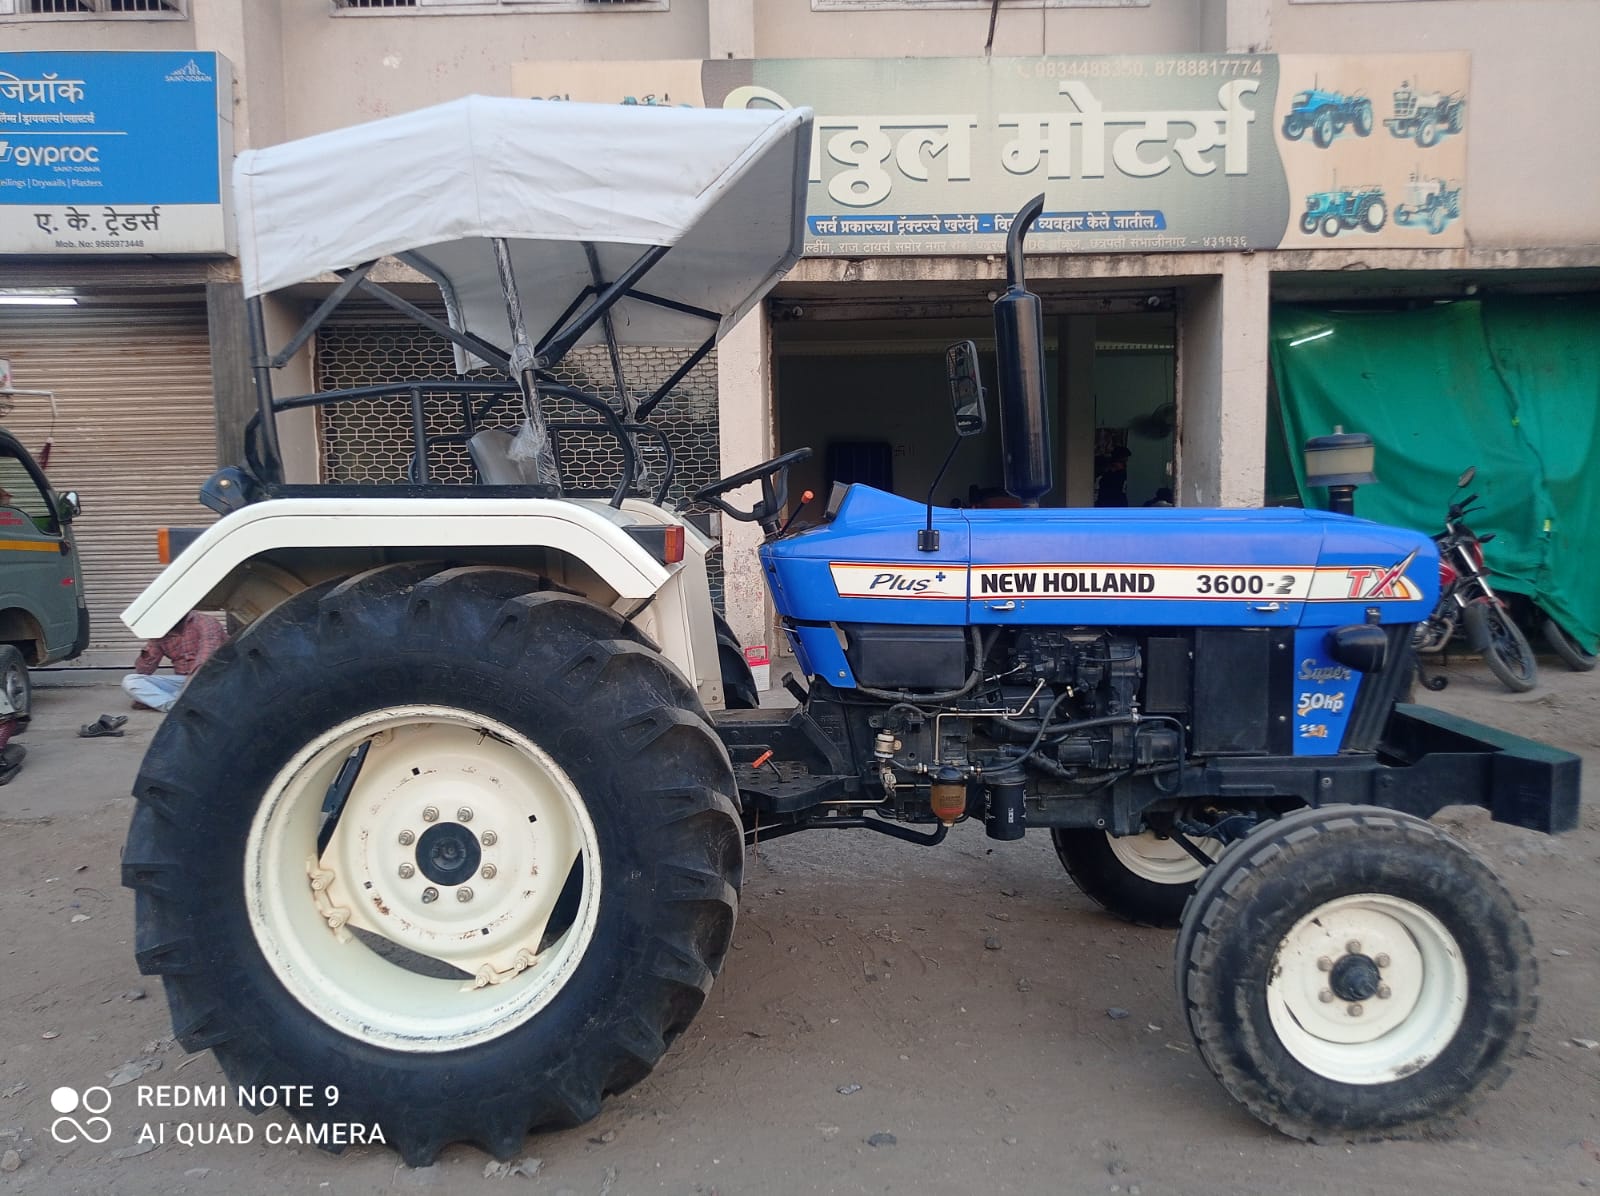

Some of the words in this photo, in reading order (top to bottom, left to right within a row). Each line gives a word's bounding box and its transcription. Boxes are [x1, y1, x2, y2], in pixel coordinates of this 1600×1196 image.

[1154, 59, 1263, 77] 8788817774
[999, 79, 1260, 180] मोटर्स
[14, 146, 100, 167] gyproc
[0, 178, 26, 188] eilings
[34, 213, 59, 234] ए.
[65, 206, 97, 232] के.
[102, 205, 160, 236] ट्रेडर्स
[816, 216, 838, 233] सर्व
[840, 220, 895, 233] प्रकारच्या
[897, 215, 941, 236] ट्रॅक्टरचे
[943, 214, 979, 234] खरेदी
[1038, 217, 1084, 233] व्यवहार
[1086, 212, 1111, 229] केले
[1113, 211, 1159, 229] जातील.
[55, 240, 77, 248] Mob.
[78, 240, 94, 248] No:
[839, 243, 859, 253] राज
[1130, 233, 1187, 248] संभाजीनगर
[1202, 235, 1248, 249] ४३११३६
[980, 573, 1037, 594] NEW
[1042, 572, 1155, 594] HOLLAND
[1196, 574, 1296, 595] 3600-2
[1346, 559, 1406, 600] TX
[1297, 658, 1352, 684] Super
[1297, 691, 1345, 714] 50hp
